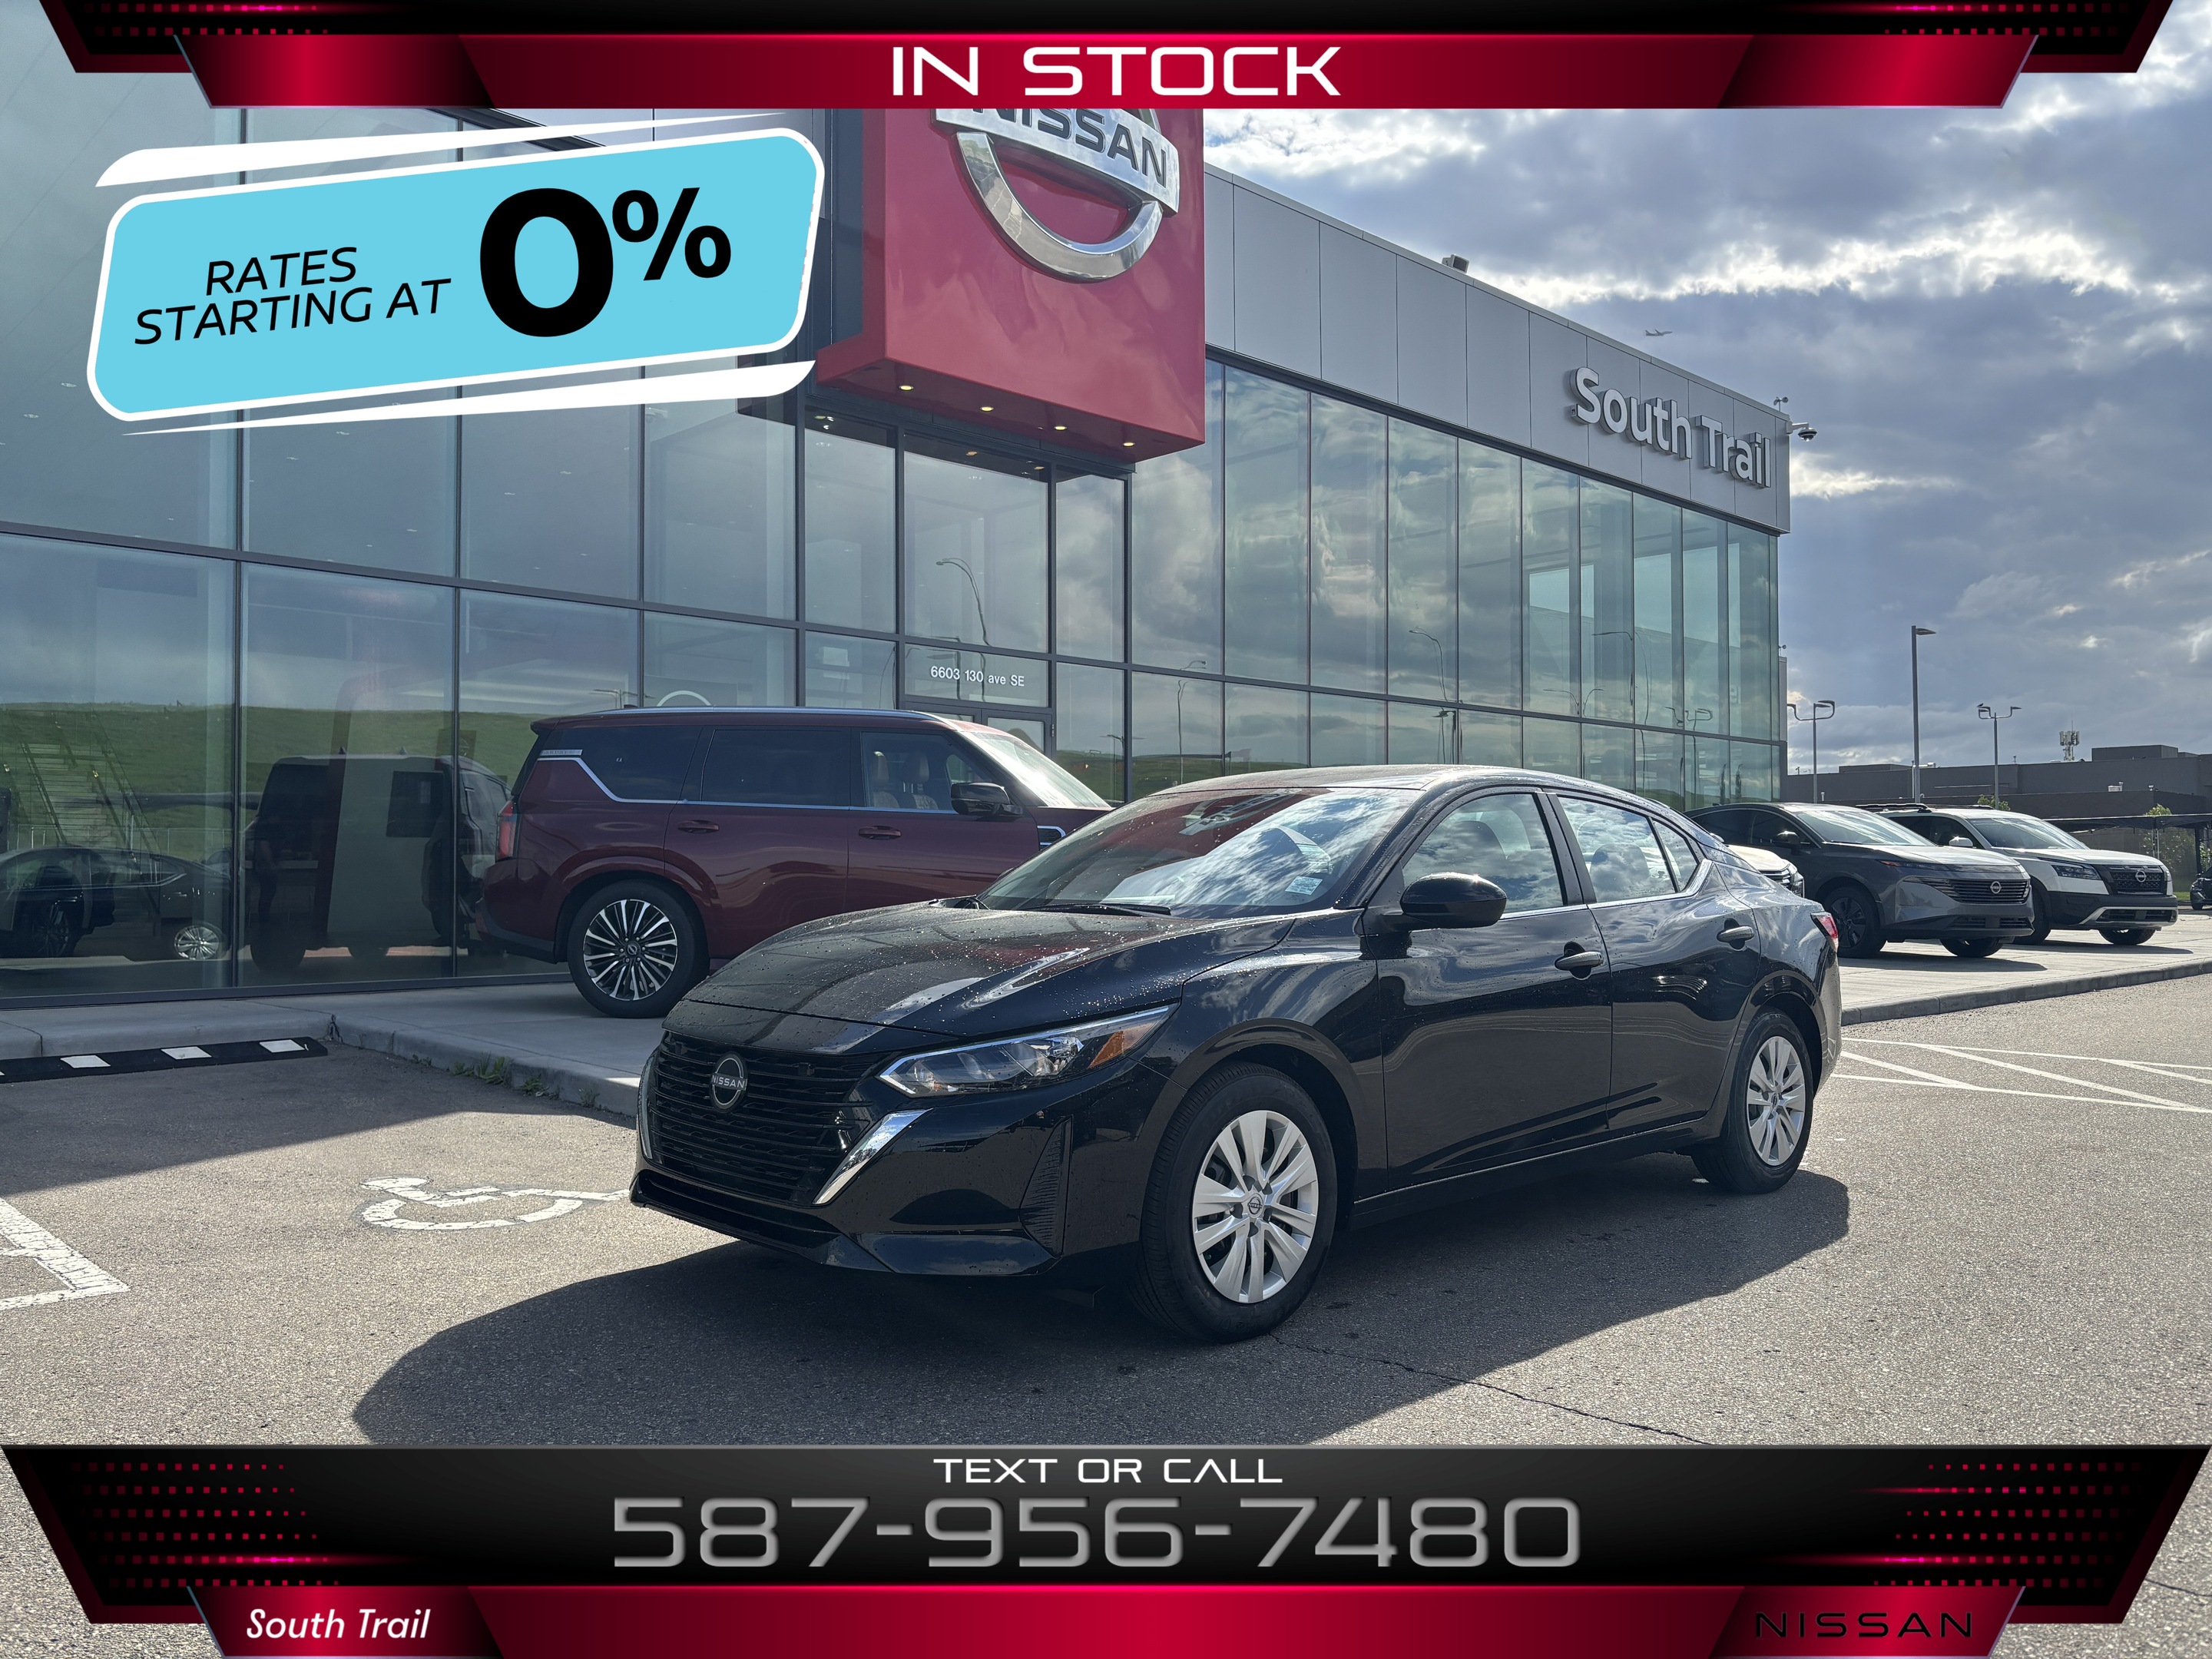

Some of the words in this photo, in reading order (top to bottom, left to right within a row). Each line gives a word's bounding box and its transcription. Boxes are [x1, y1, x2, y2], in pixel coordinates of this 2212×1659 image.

[972, 108, 1167, 189] SSAN
[1571, 366, 1693, 459] South
[1696, 415, 1771, 488] Trail
[930, 666, 960, 680] 6603
[965, 670, 984, 682] 130
[988, 674, 1006, 685] ave
[1010, 674, 1025, 687] SE
[711, 1075, 745, 1088] NISSAN
